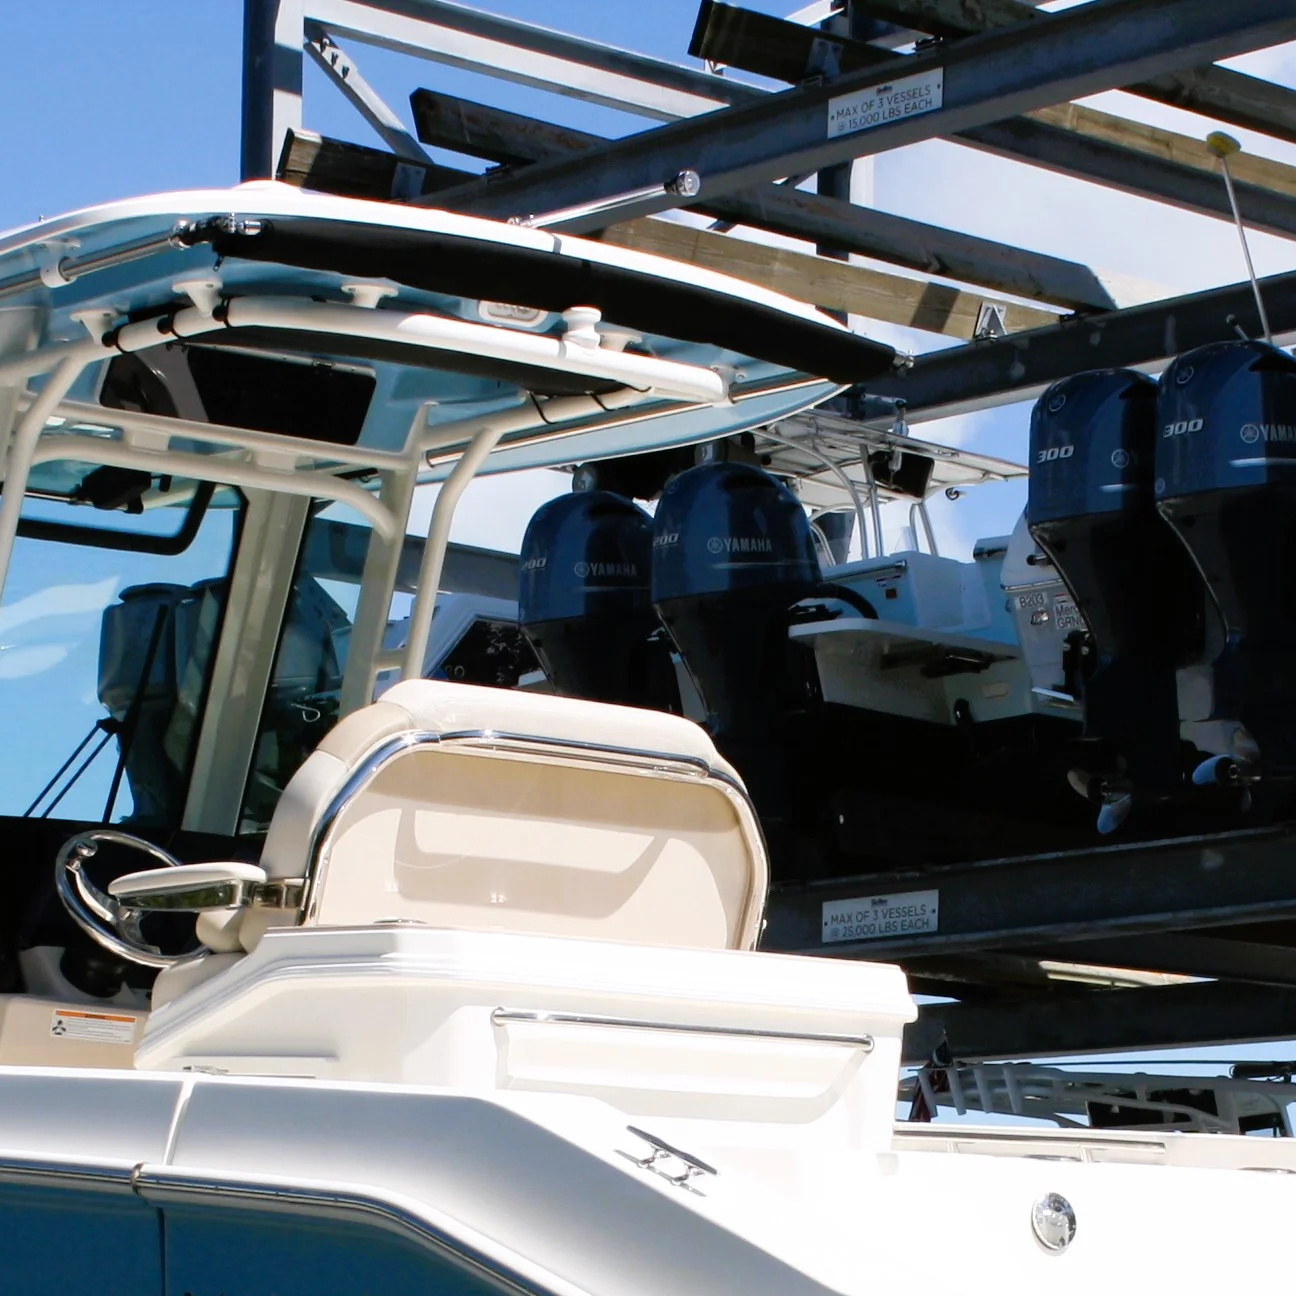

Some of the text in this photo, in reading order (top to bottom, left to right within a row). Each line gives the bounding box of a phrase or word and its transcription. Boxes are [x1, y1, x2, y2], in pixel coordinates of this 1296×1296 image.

[836, 104, 859, 120] MAX
[861, 100, 875, 115] OF
[878, 96, 884, 108] 3
[886, 85, 931, 105] VESSELS
[882, 107, 902, 121] LBS
[904, 98, 933, 114] EACH
[1163, 418, 1204, 438] 300
[1036, 445, 1075, 464] 300
[723, 537, 774, 554] YAMAHA
[590, 562, 638, 578] YAMAHA
[831, 904, 927, 925] MAX OF 3 VESSELS
[878, 920, 898, 934] LBS
[900, 918, 930, 931] EACH
